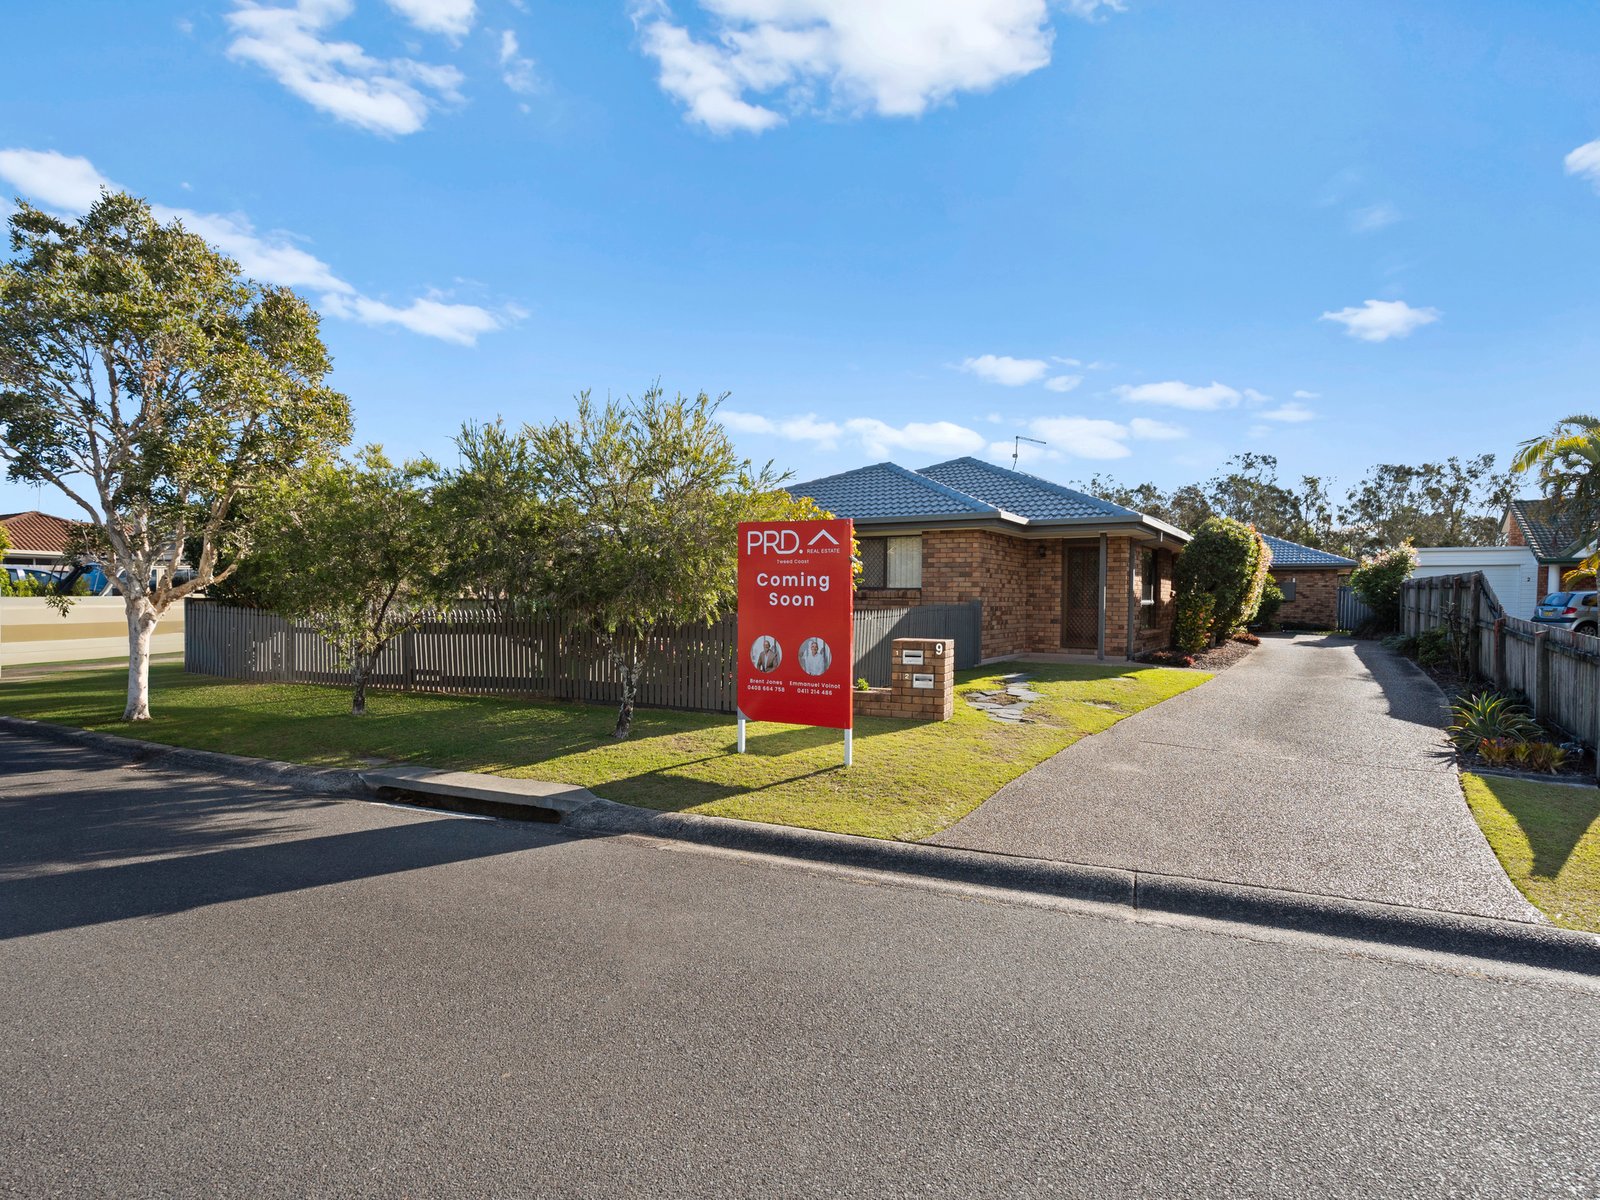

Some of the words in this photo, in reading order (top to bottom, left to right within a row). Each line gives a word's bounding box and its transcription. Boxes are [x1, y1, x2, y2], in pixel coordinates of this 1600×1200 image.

[756, 572, 830, 592] Coming
[769, 592, 815, 607] Soon
[936, 643, 943, 655] 9
